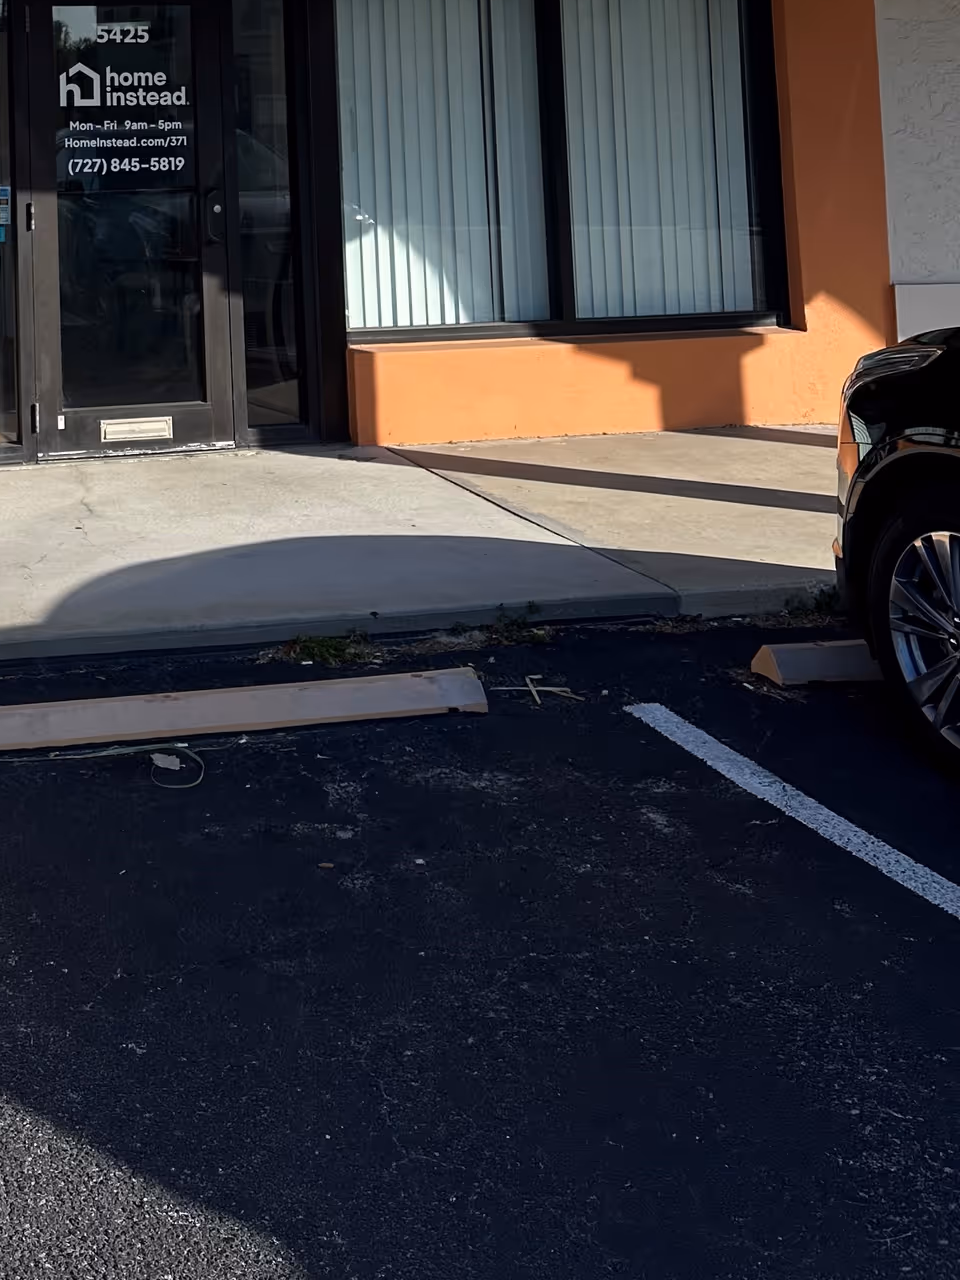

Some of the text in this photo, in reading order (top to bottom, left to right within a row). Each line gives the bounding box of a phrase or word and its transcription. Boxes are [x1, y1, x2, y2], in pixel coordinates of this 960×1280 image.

[96, 25, 150, 44] 5425
[105, 65, 167, 87] home
[69, 120, 94, 131] Mon
[103, 120, 118, 131] Fri
[124, 119, 148, 130] 9am
[158, 119, 182, 133] 5pm
[64, 136, 187, 149] HomeInstead.com/371
[68, 157, 185, 176] (727) 845-5819
